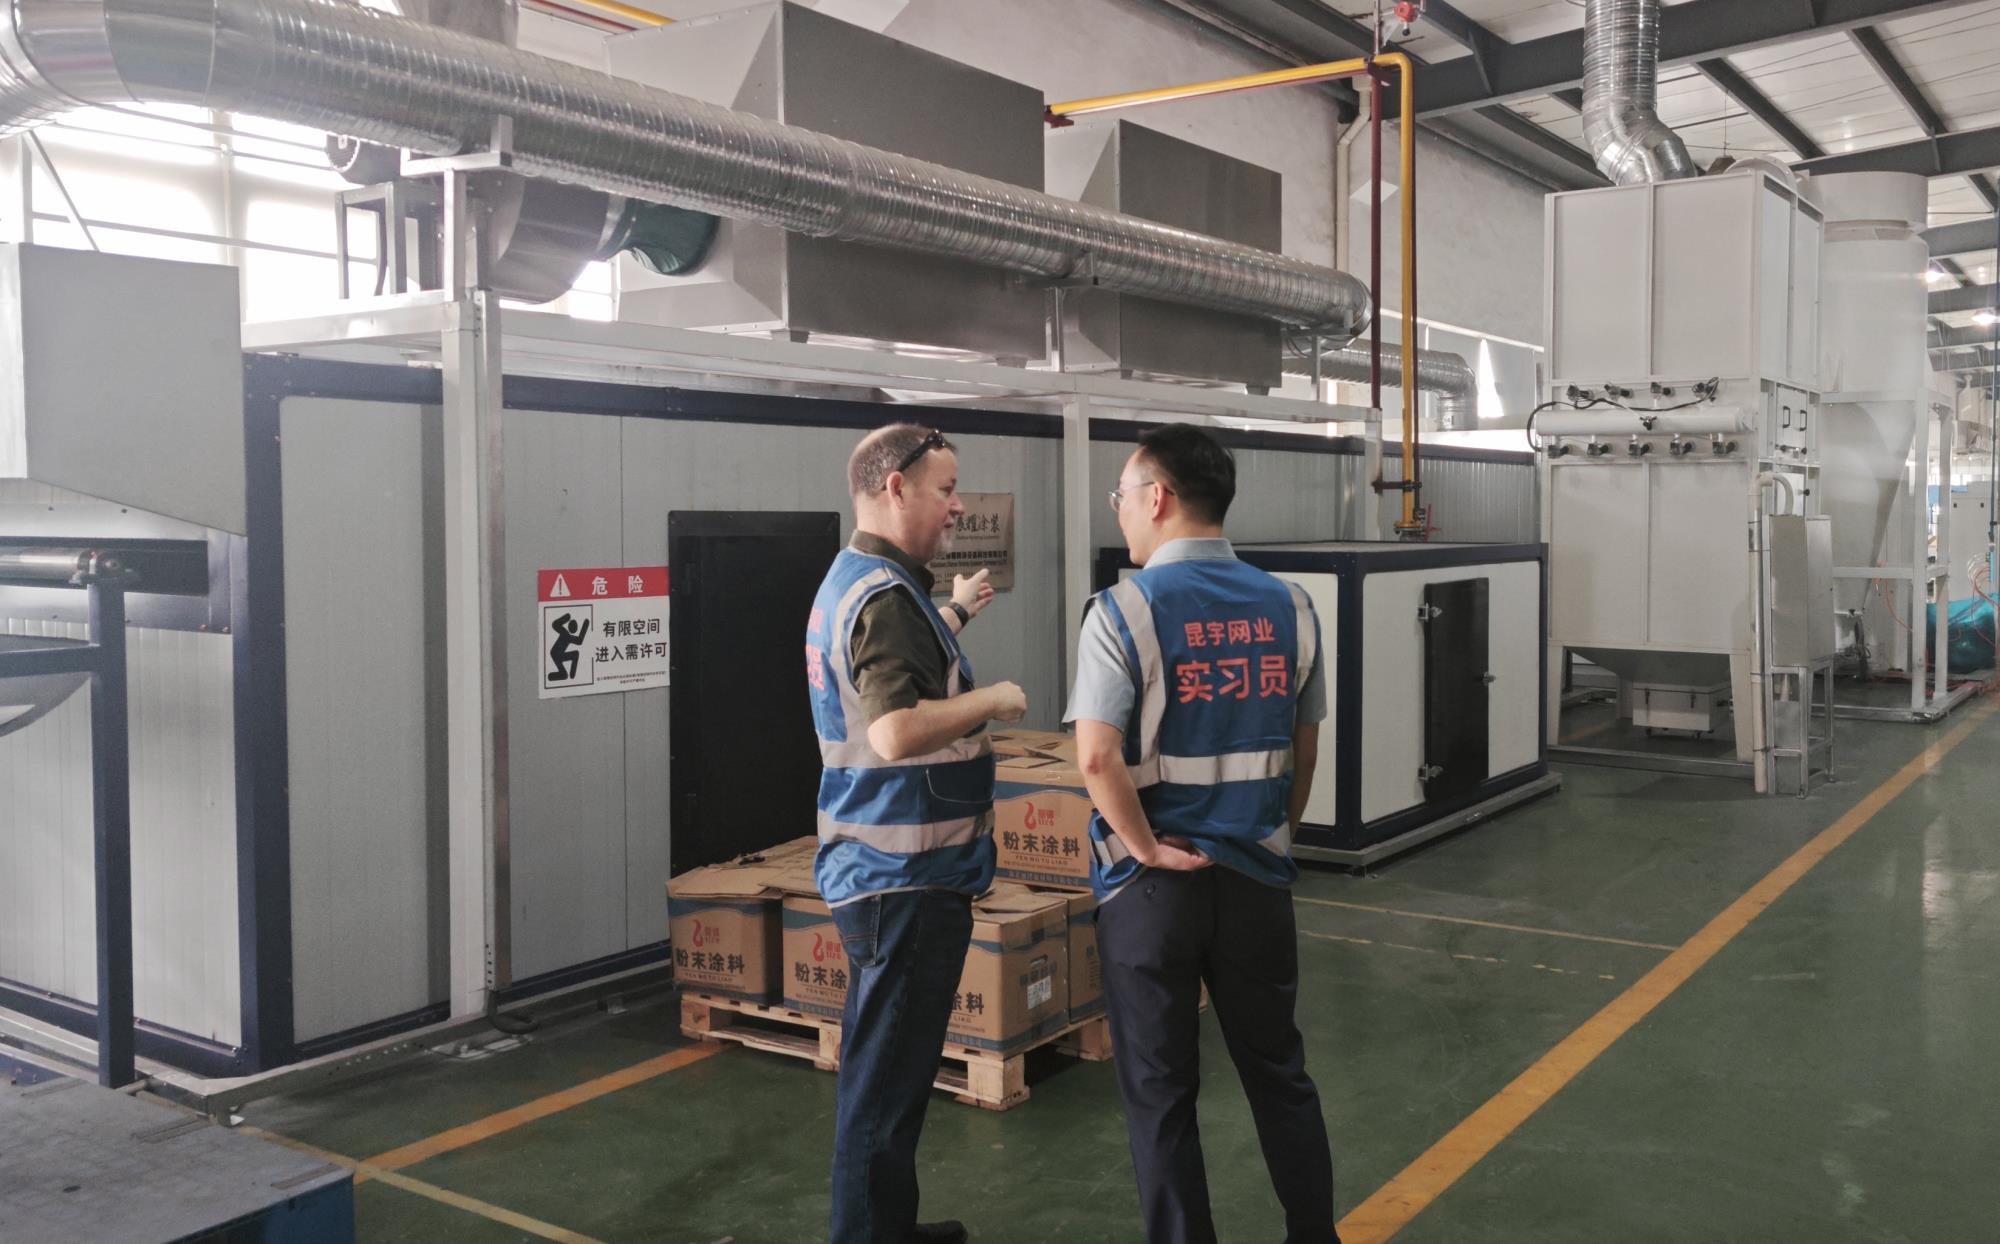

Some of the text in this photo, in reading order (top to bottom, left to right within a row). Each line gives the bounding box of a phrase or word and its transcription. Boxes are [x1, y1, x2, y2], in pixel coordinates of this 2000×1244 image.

[592, 574, 644, 596] 危险
[602, 618, 660, 638] 有限空间
[1184, 616, 1275, 647] 昆宇网业
[595, 642, 667, 663] 进入需许可
[1176, 655, 1288, 704] 实习员
[1003, 831, 1080, 857] 粉末涂料
[676, 947, 745, 975] 粉末涂料
